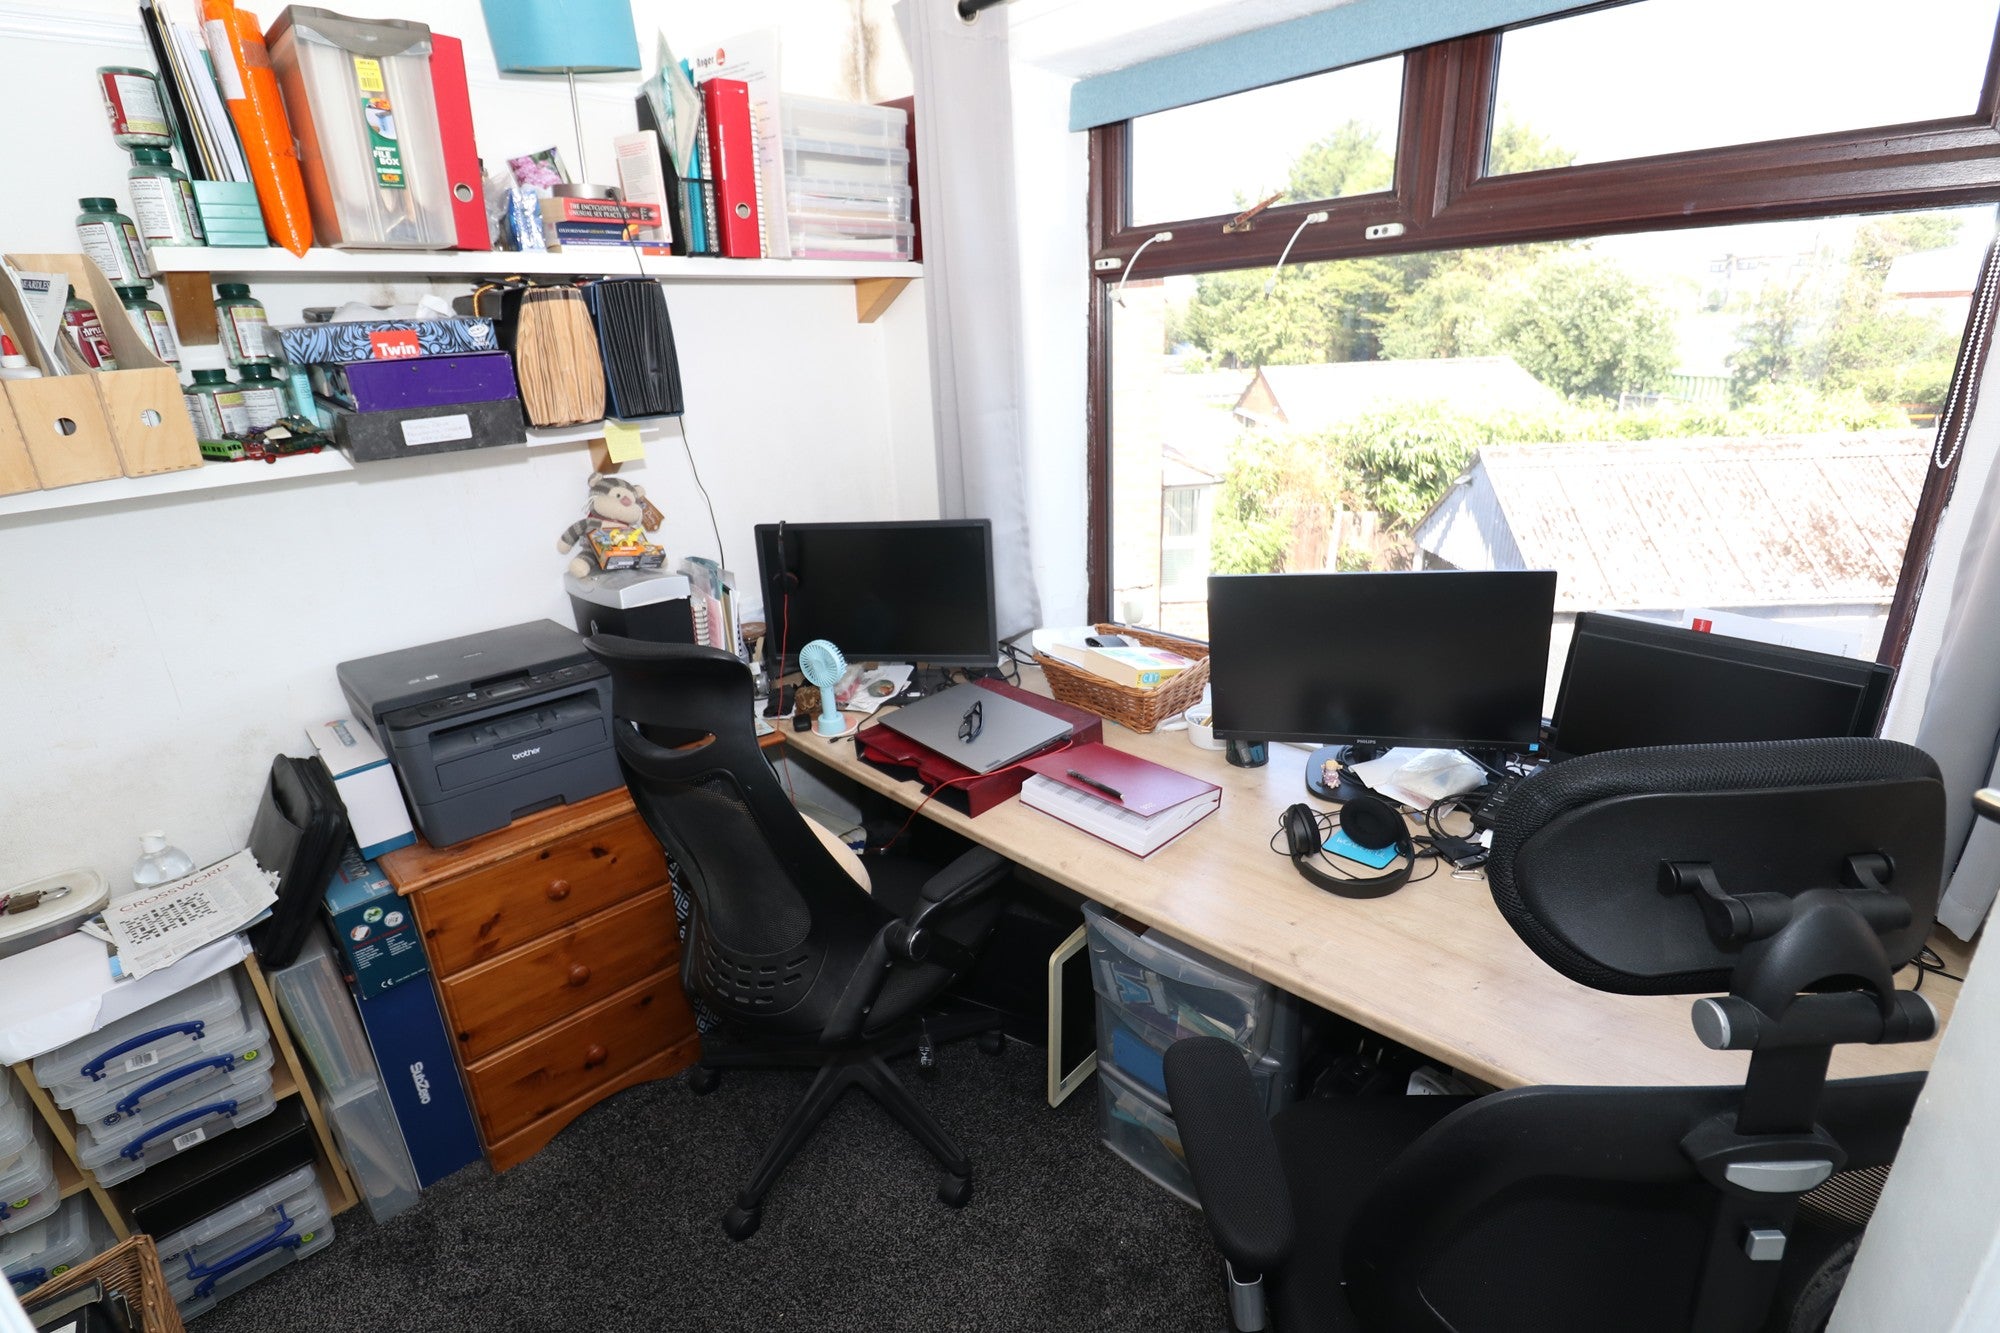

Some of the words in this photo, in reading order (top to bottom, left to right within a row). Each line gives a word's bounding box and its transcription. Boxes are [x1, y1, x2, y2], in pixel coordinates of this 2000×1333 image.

[373, 150, 392, 159] FILE
[379, 157, 401, 167] BOX
[603, 211, 630, 219] PRACTIES
[376, 342, 417, 357] Twin
[511, 747, 541, 761] brother
[119, 863, 230, 913] CROSSWORD
[409, 1061, 431, 1105] SubZero
